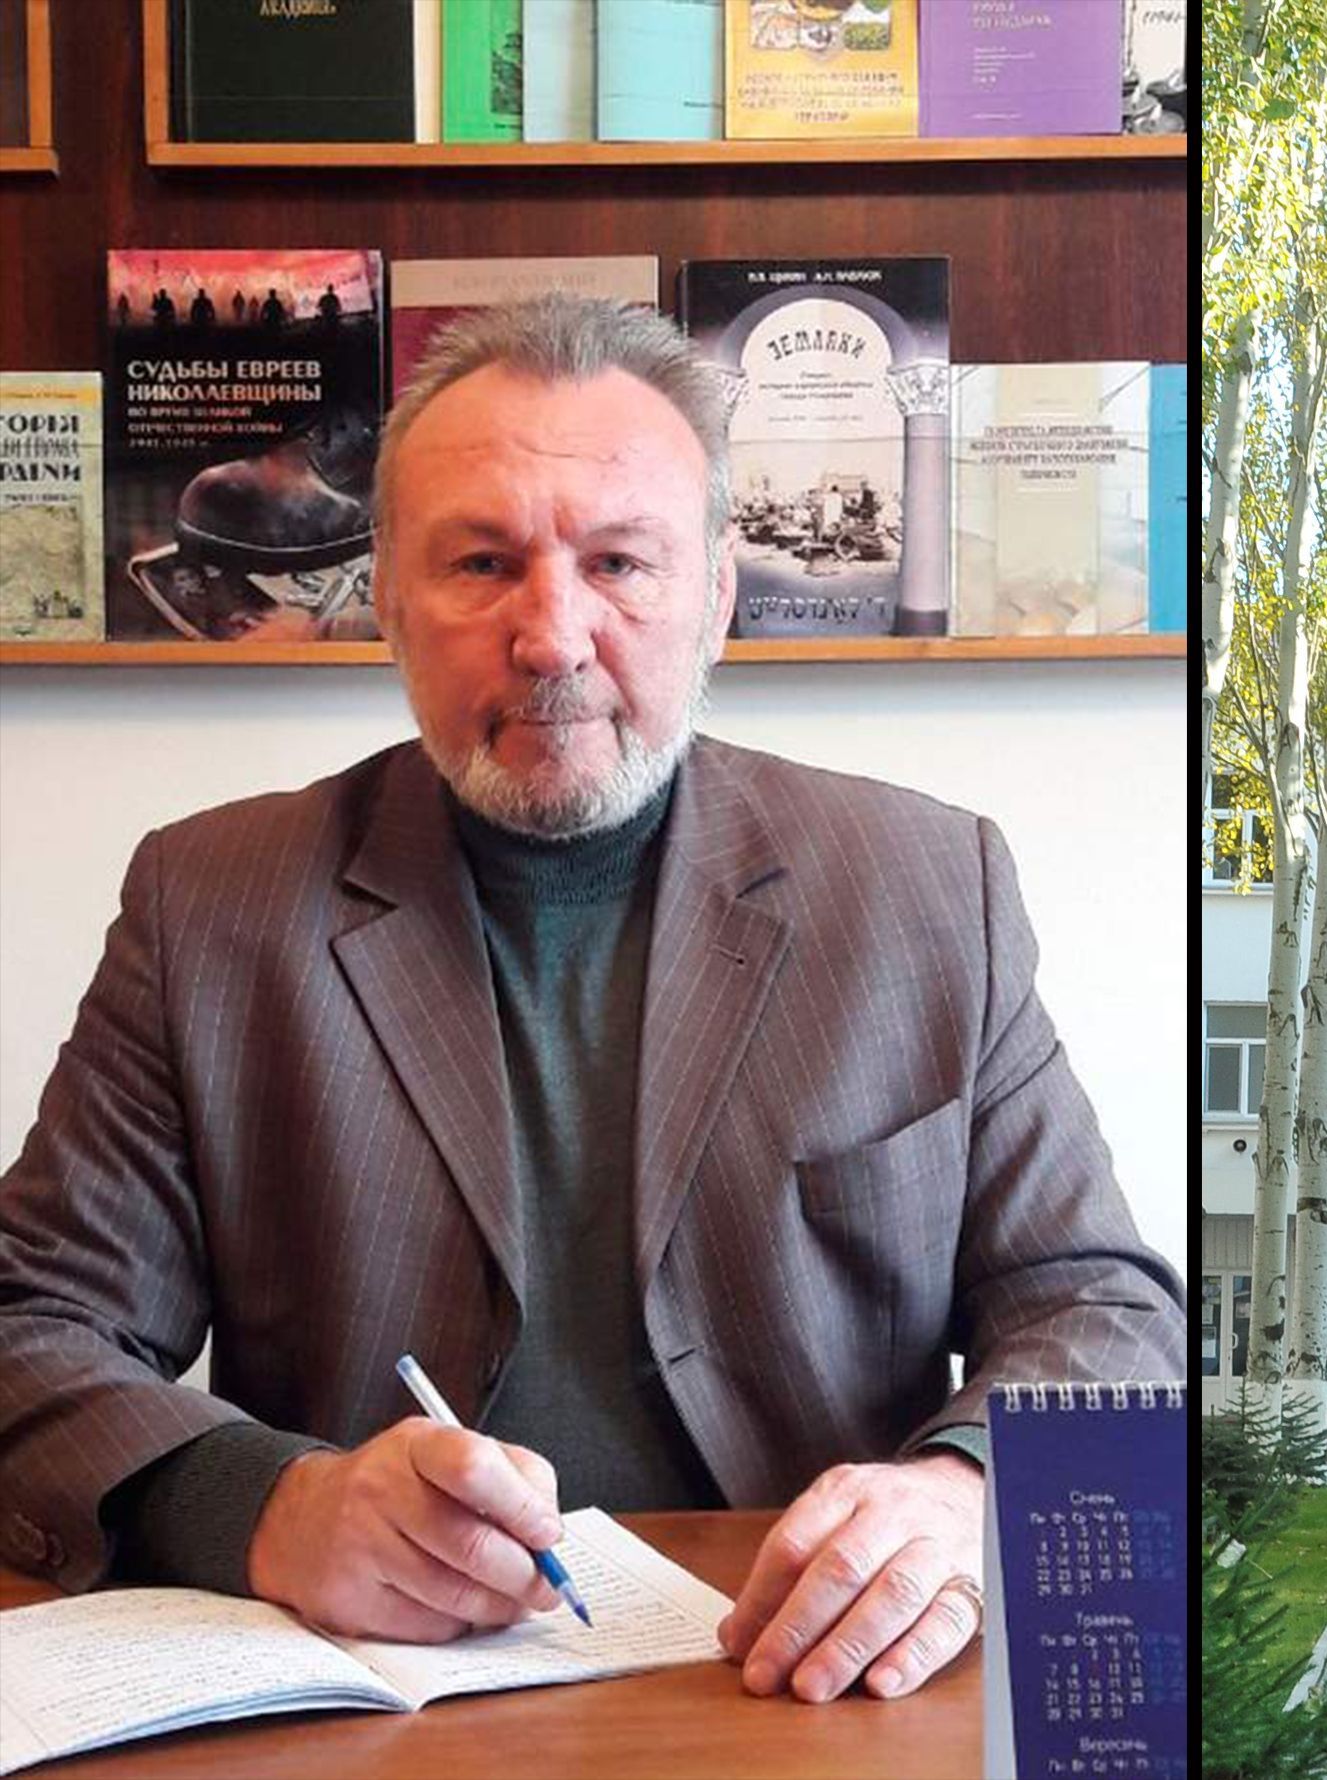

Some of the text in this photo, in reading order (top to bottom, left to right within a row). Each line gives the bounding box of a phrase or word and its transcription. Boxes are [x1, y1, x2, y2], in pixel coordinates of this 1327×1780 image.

[766, 329, 867, 361] ЗЕМЛЯКИ
[127, 361, 321, 383] СУДЬБЫ ЕВРЕЕВ
[127, 384, 322, 406] НИКОЛАЕВЩИНЫ
